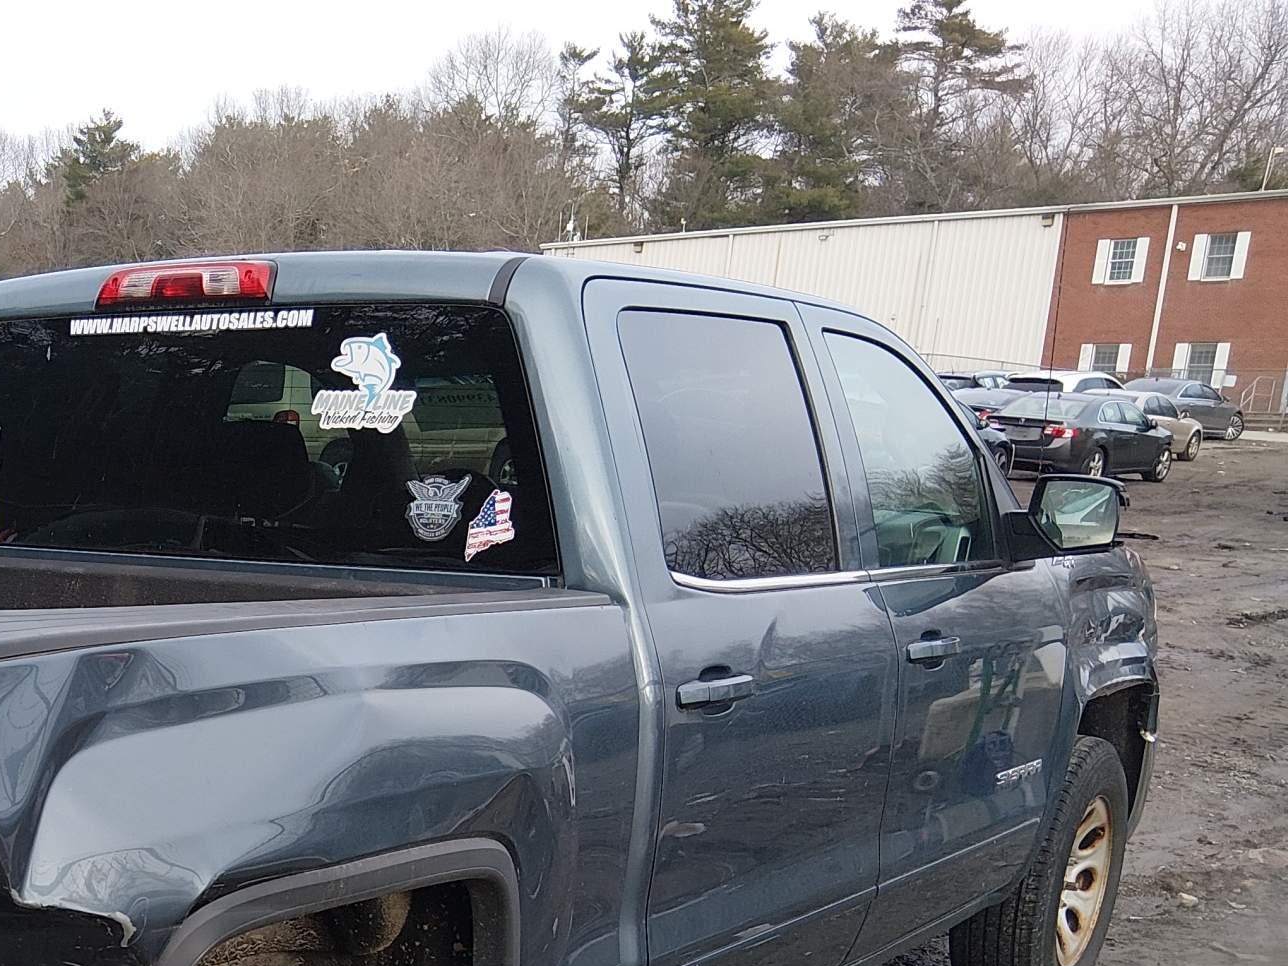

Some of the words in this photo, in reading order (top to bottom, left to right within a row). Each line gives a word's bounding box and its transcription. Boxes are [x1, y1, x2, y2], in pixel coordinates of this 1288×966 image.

[70, 309, 314, 336] WWW.HARPSWELLAUTOSALES.COM
[314, 392, 366, 411] MAINE
[372, 393, 414, 411] LINE
[323, 411, 360, 425] Wicked
[360, 410, 399, 429] Fishing
[415, 503, 424, 513] WE
[424, 502, 433, 513] THE
[433, 503, 453, 514] PEOPLE
[995, 758, 1043, 785] SIERRA
